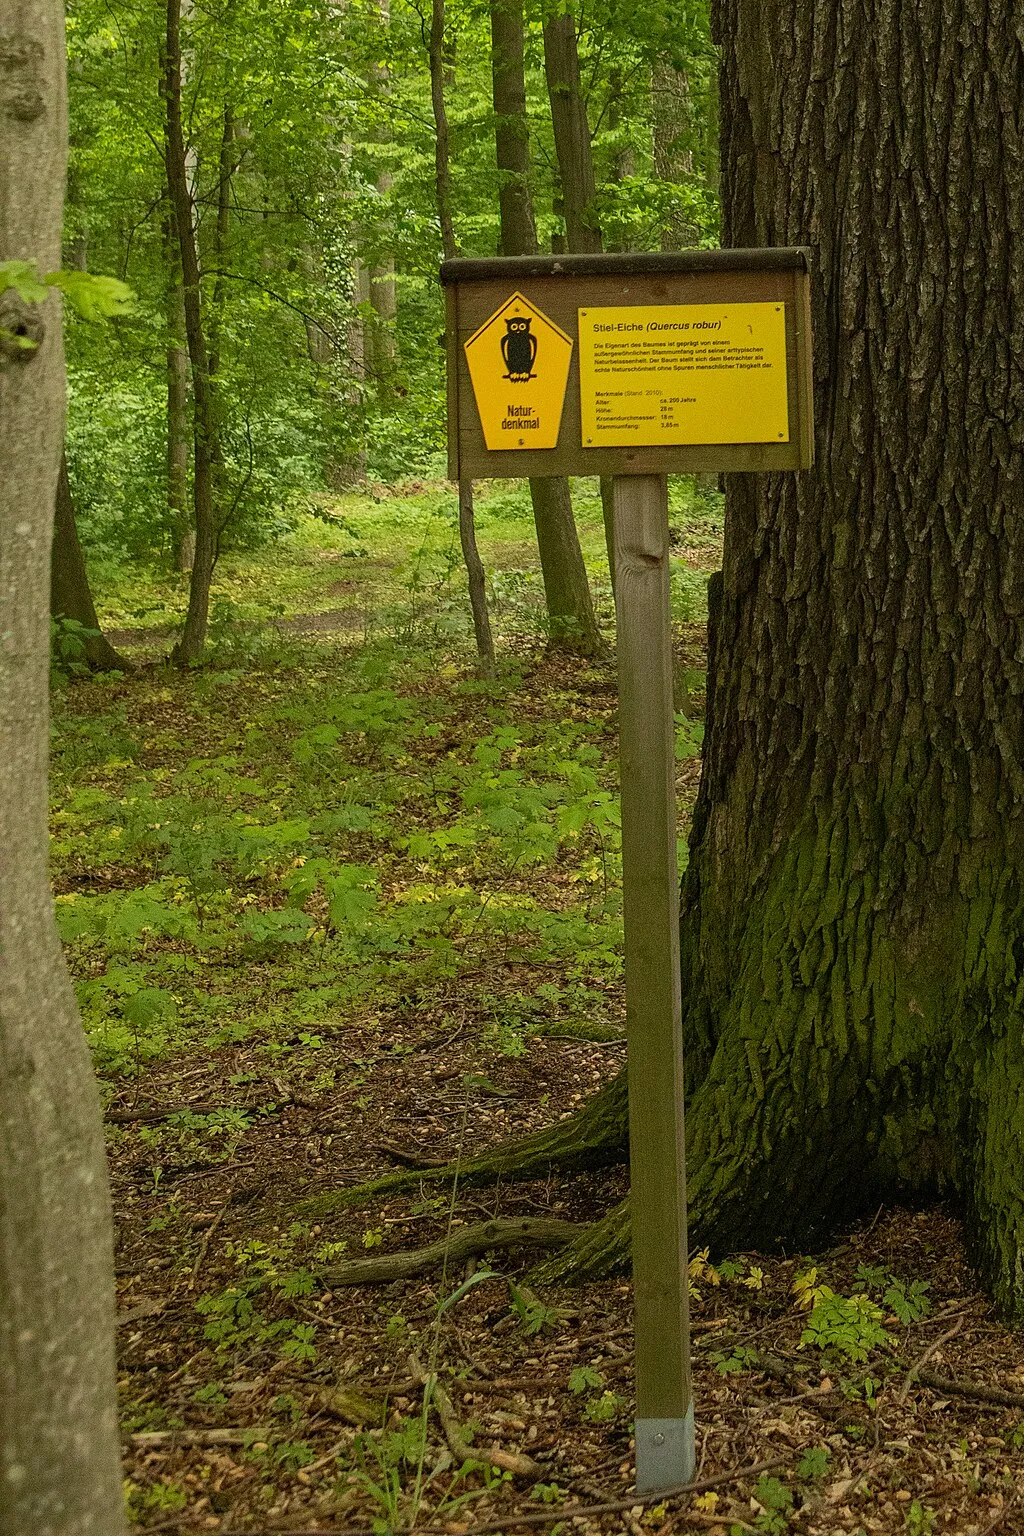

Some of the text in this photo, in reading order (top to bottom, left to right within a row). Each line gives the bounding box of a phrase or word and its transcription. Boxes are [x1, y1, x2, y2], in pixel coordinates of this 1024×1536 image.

[594, 321, 722, 332] Stiel-Eiche (Quercus robur)
[508, 405, 535, 417] Natur-
[502, 418, 539, 430] denkmal
